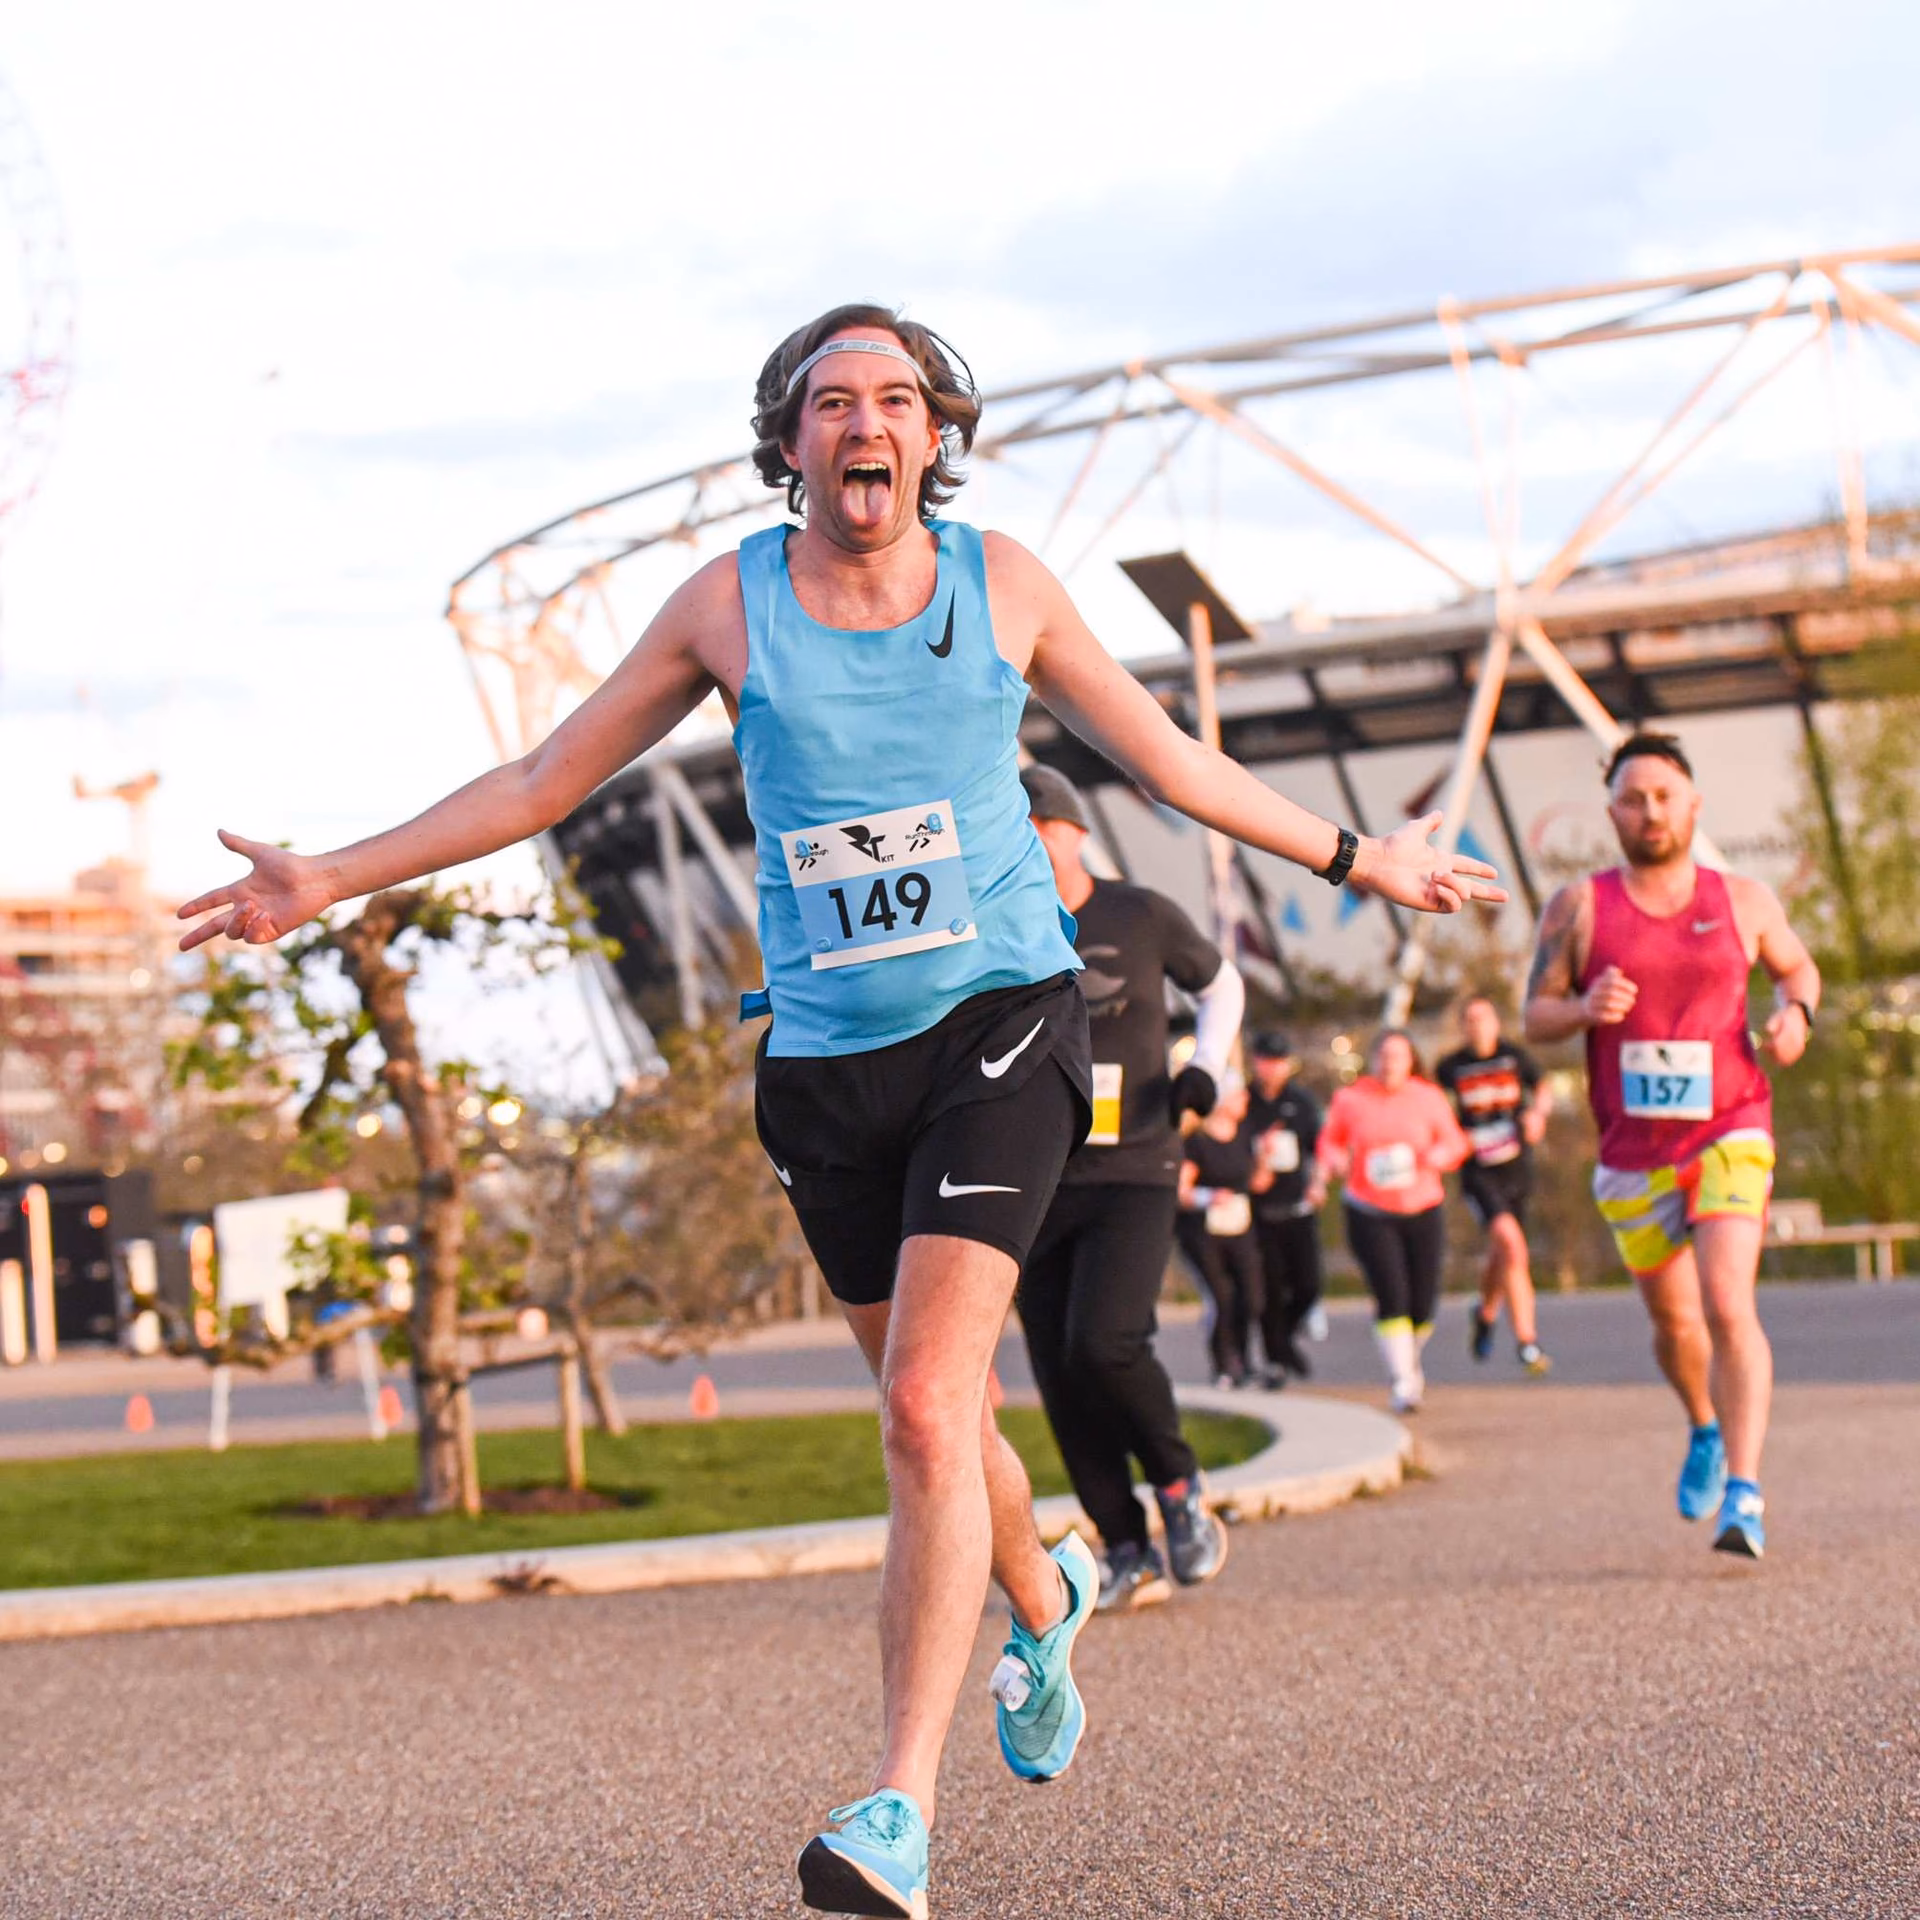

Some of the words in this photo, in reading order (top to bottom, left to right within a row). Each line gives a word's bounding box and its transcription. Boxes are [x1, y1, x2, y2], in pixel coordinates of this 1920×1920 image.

[881, 854, 895, 863] KIT
[828, 872, 931, 939] 149
[1637, 1074, 1692, 1105] 157
